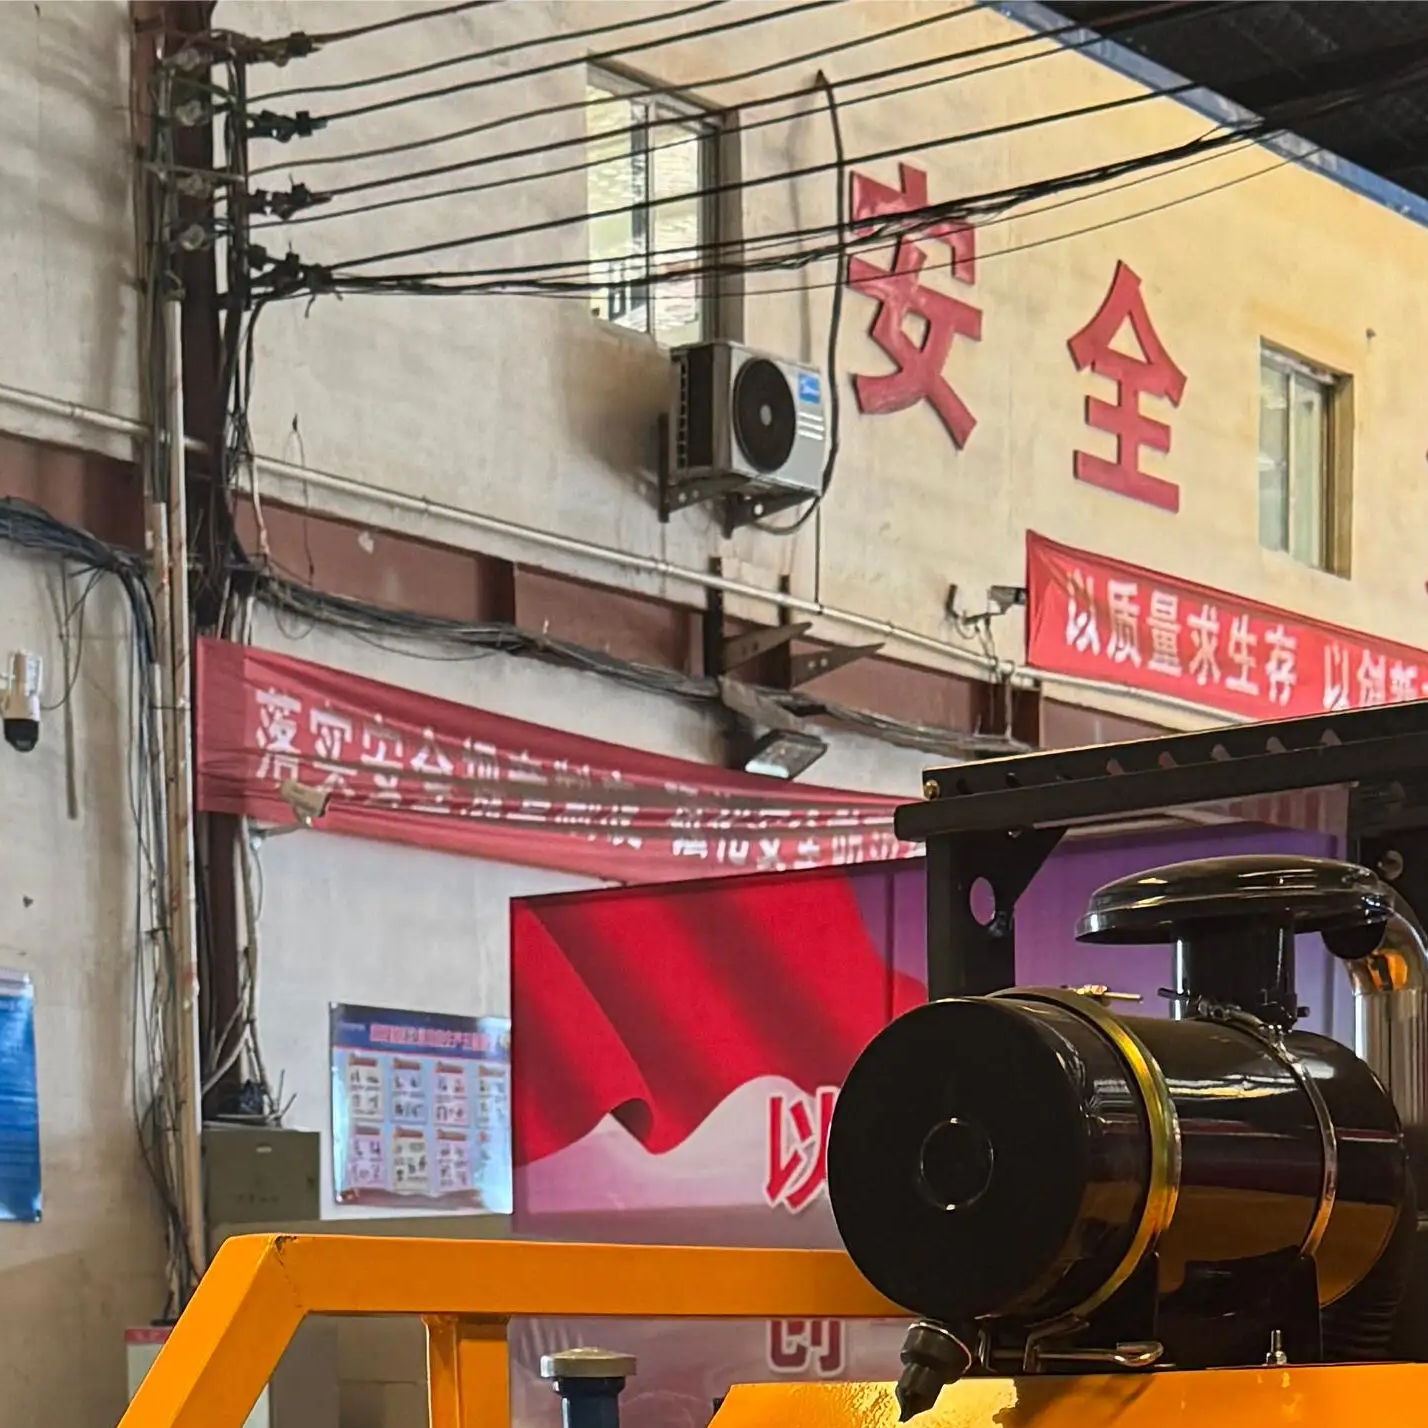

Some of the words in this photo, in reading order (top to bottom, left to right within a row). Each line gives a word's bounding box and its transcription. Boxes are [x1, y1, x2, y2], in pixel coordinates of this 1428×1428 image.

[1065, 567, 1299, 707] 以质量求生存
